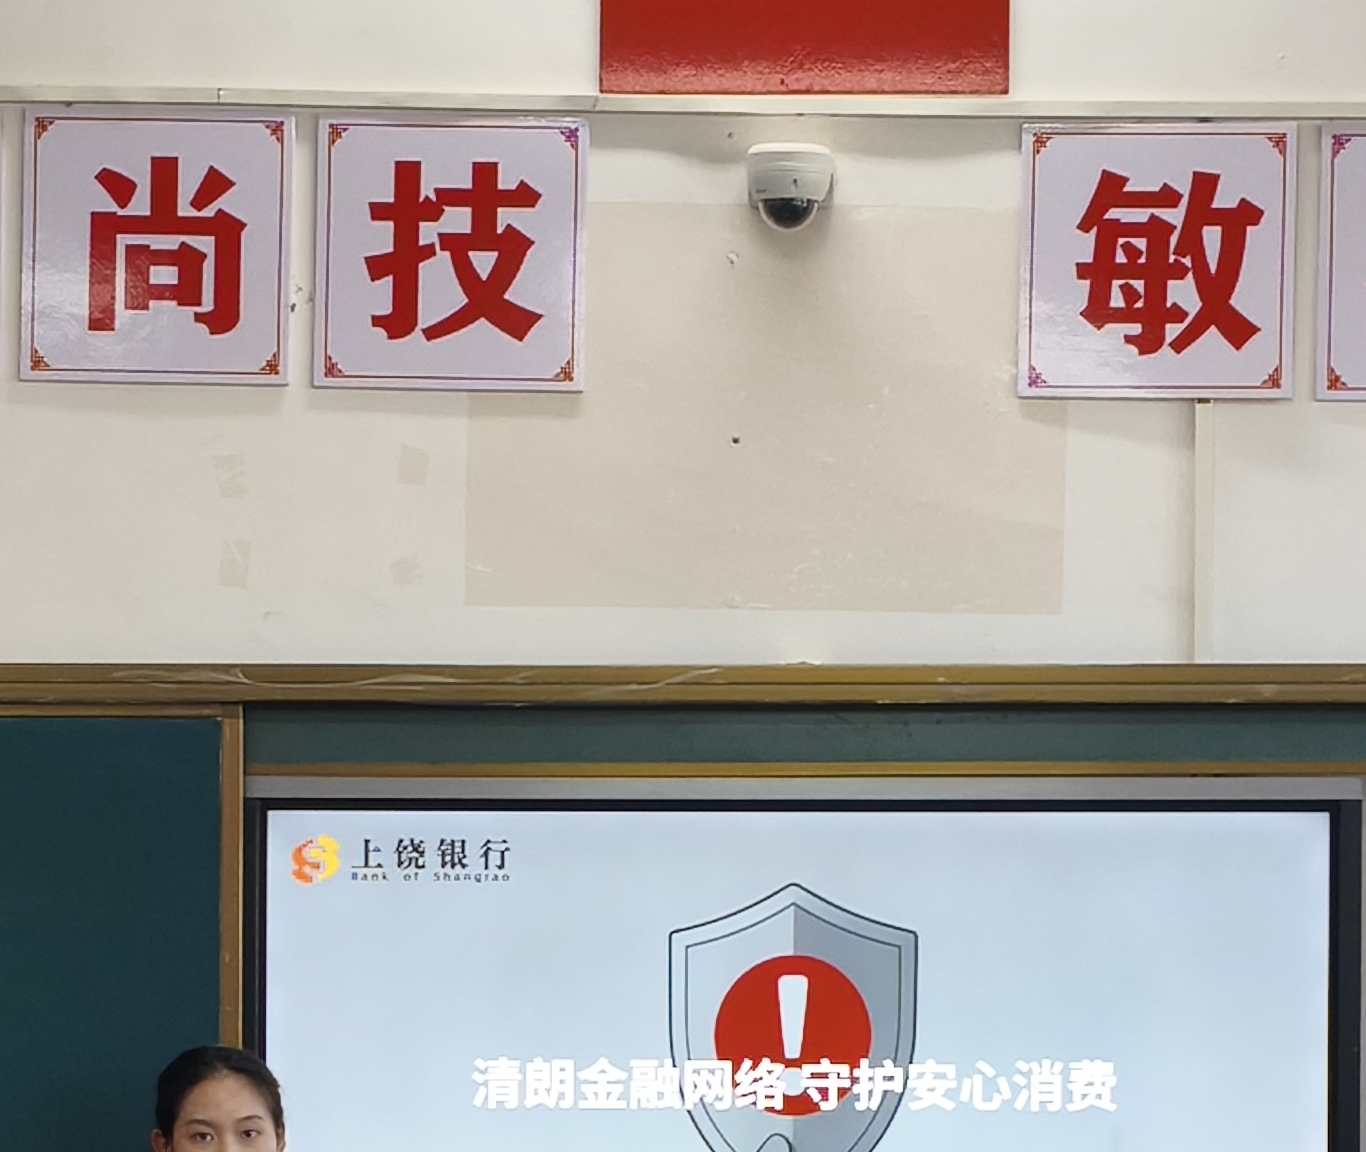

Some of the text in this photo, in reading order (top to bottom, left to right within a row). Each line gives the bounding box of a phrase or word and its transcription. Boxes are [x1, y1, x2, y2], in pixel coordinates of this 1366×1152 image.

[351, 838, 511, 870] 上饶银行
[351, 872, 510, 883] Bank of Shangrao
[471, 1056, 1117, 1113] 清朗金融网络 守护安心消费
